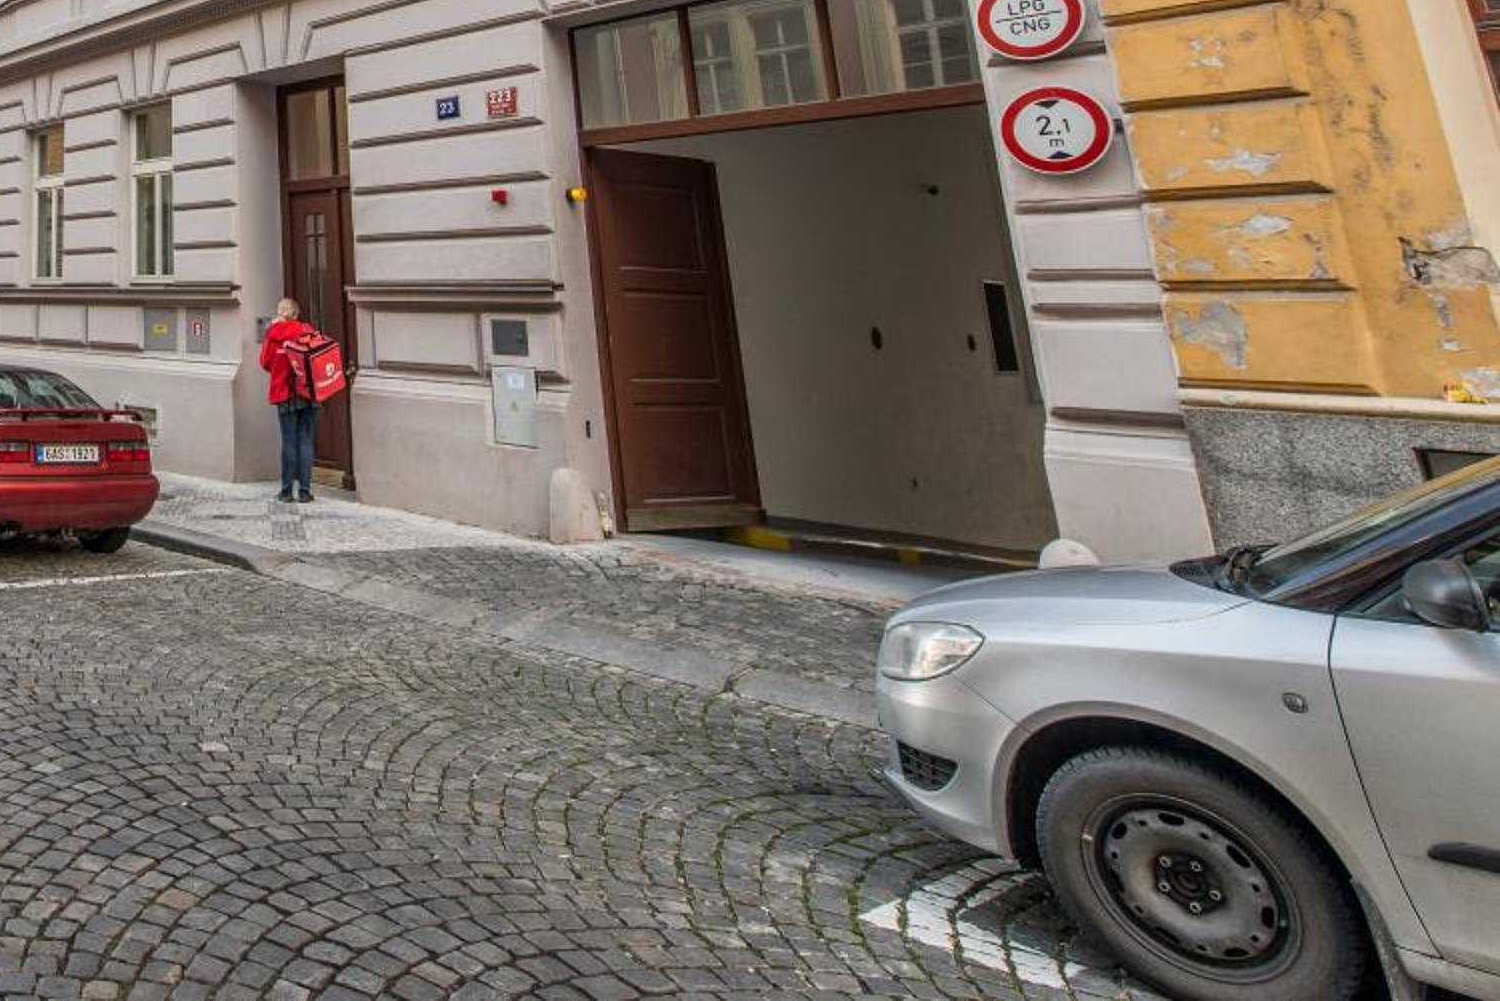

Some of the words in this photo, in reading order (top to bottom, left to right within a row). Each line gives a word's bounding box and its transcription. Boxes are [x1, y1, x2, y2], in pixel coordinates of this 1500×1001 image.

[1008, 0, 1045, 15] LPG
[1010, 18, 1050, 35] CNG
[439, 102, 455, 115] 23
[1050, 138, 1065, 147] m
